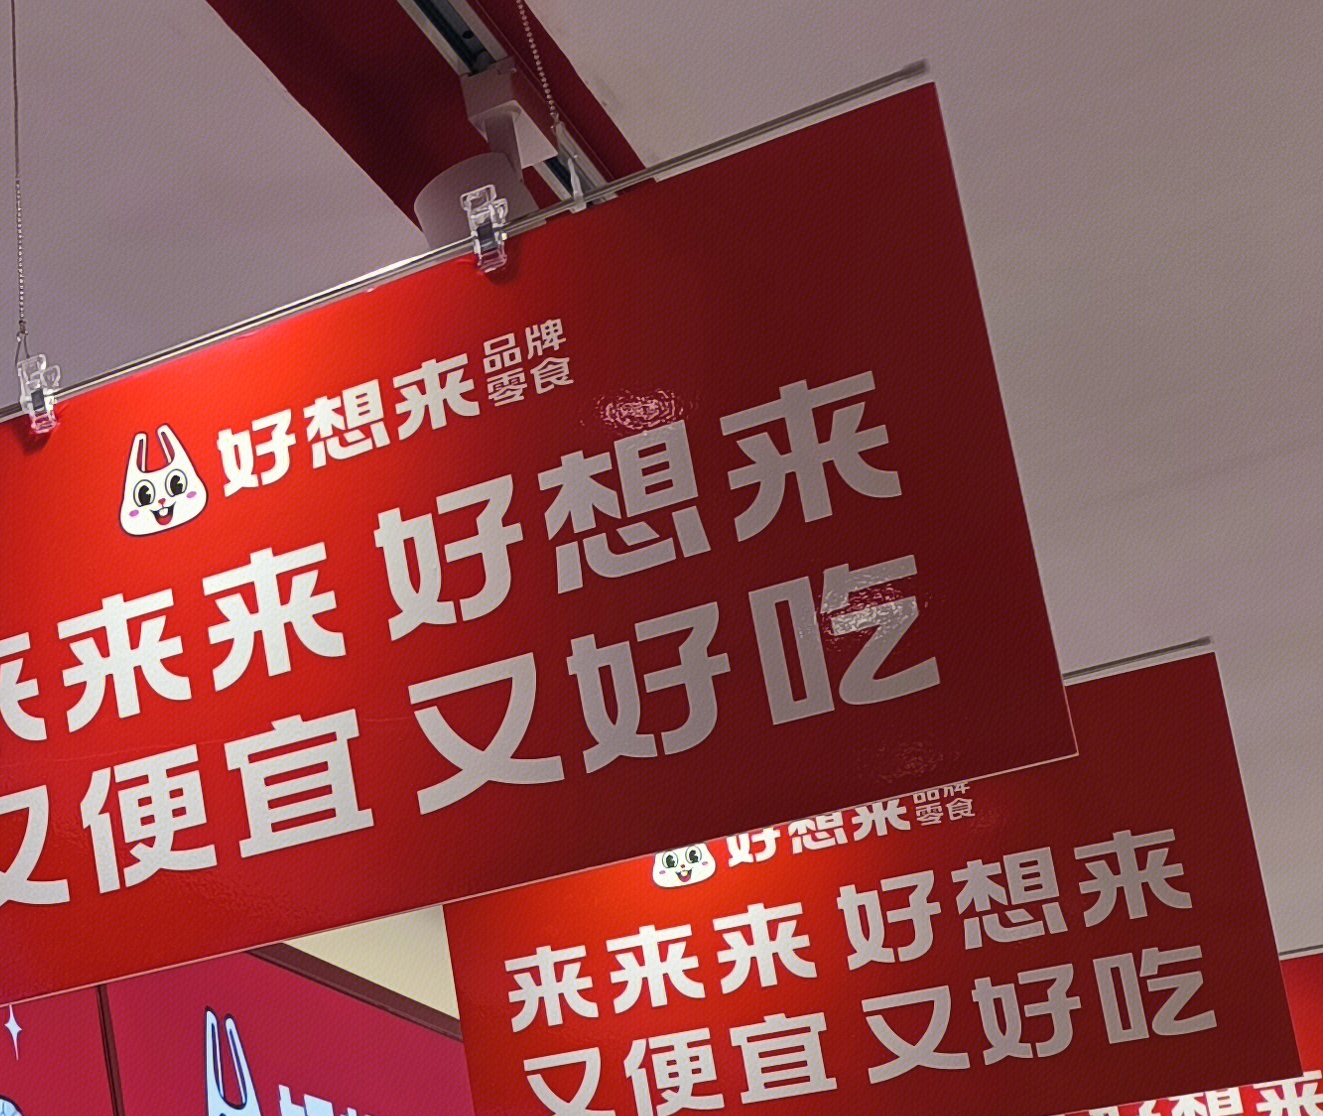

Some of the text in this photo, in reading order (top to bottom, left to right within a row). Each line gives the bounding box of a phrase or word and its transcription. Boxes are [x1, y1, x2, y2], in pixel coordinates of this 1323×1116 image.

[483, 318, 566, 373] 品牌
[486, 356, 574, 408] 零食
[217, 353, 480, 497] 好想来
[374, 370, 904, 641] 好想来
[409, 553, 942, 804] 又好吃
[915, 798, 976, 827] 零食
[504, 829, 1193, 1033] 来来来 好想来
[862, 945, 1218, 1085] 又好吃
